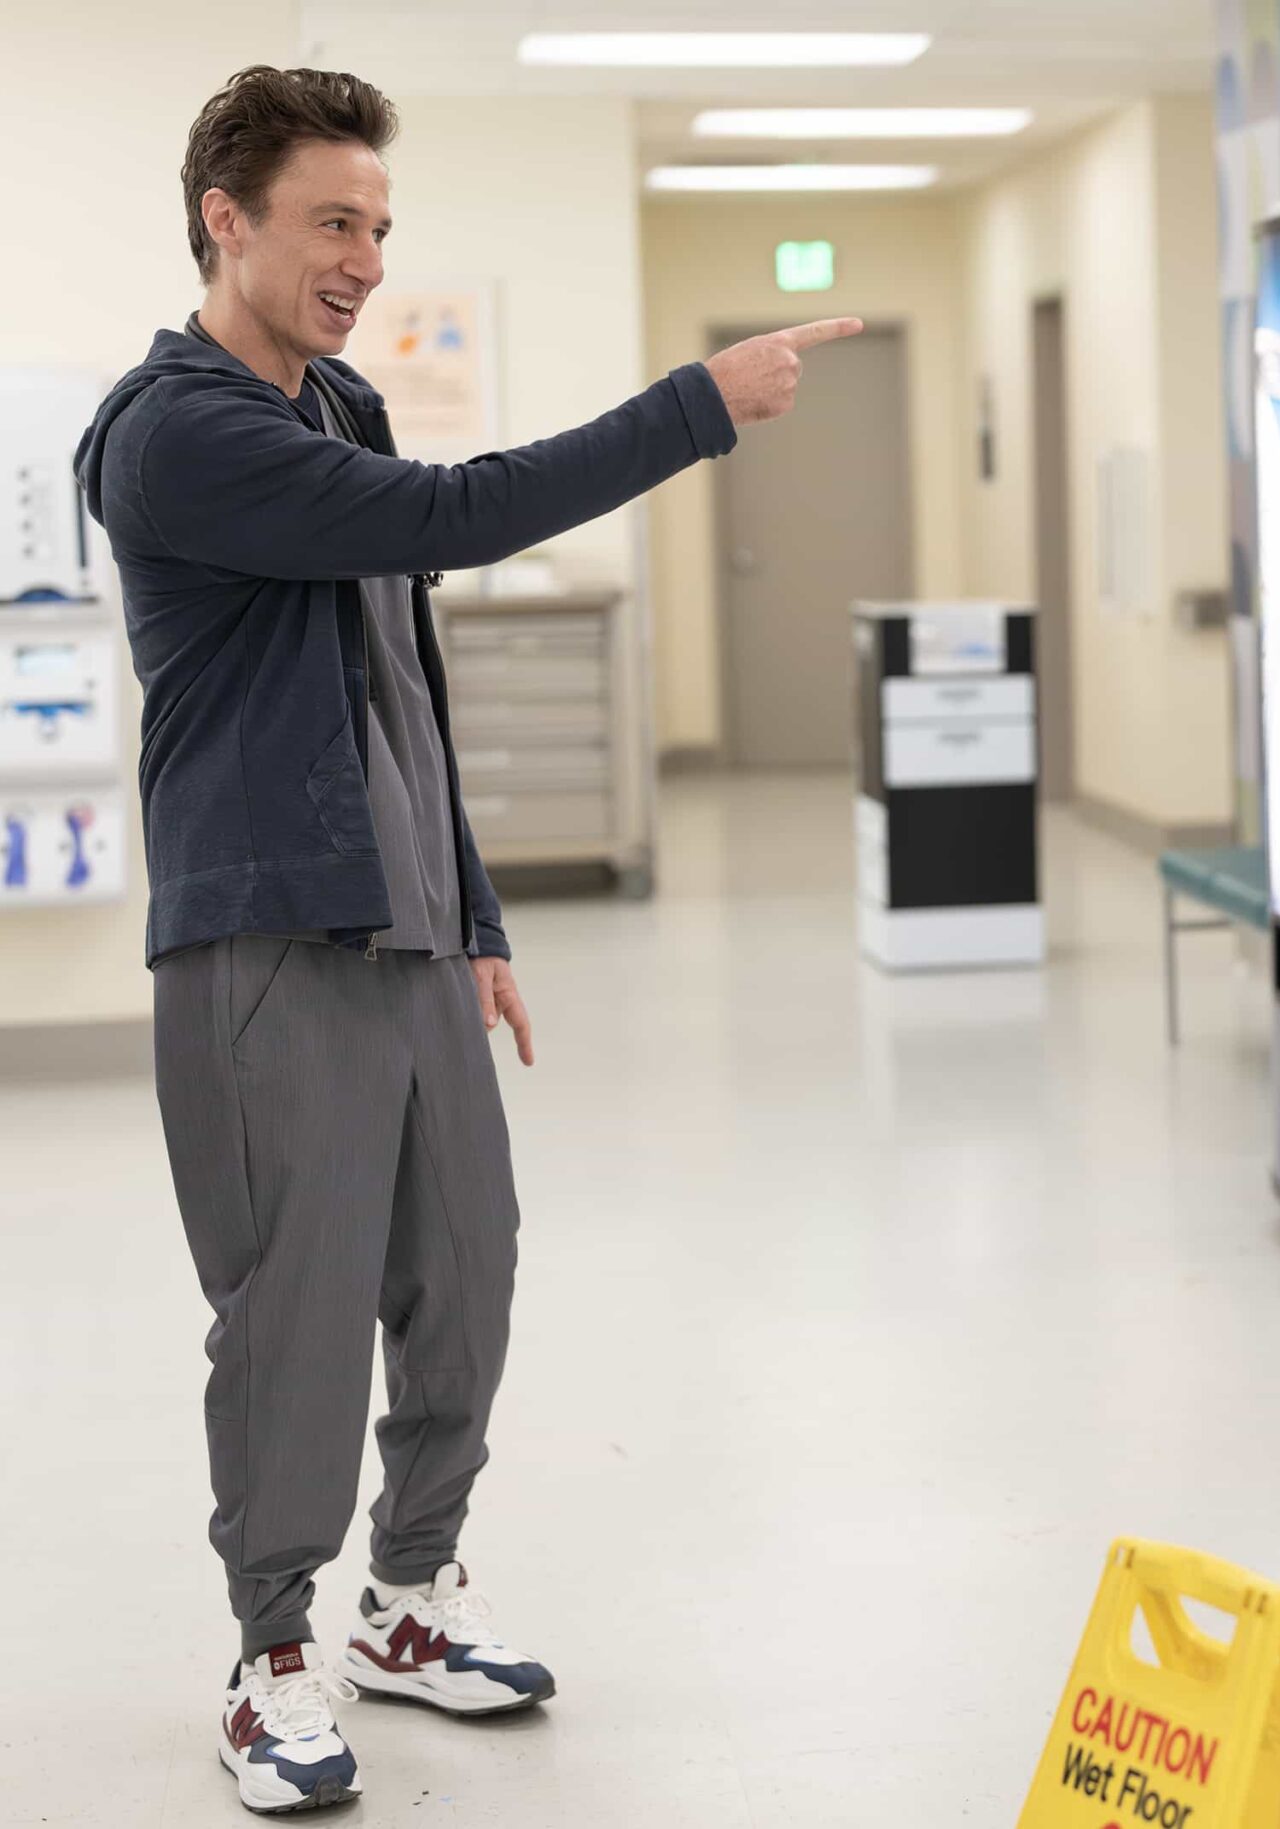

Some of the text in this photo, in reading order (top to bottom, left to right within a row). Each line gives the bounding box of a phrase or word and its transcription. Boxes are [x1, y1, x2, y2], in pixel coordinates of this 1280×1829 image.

[1070, 1687, 1219, 1787] CAUTION
[1061, 1742, 1194, 1829] Wet Floor
